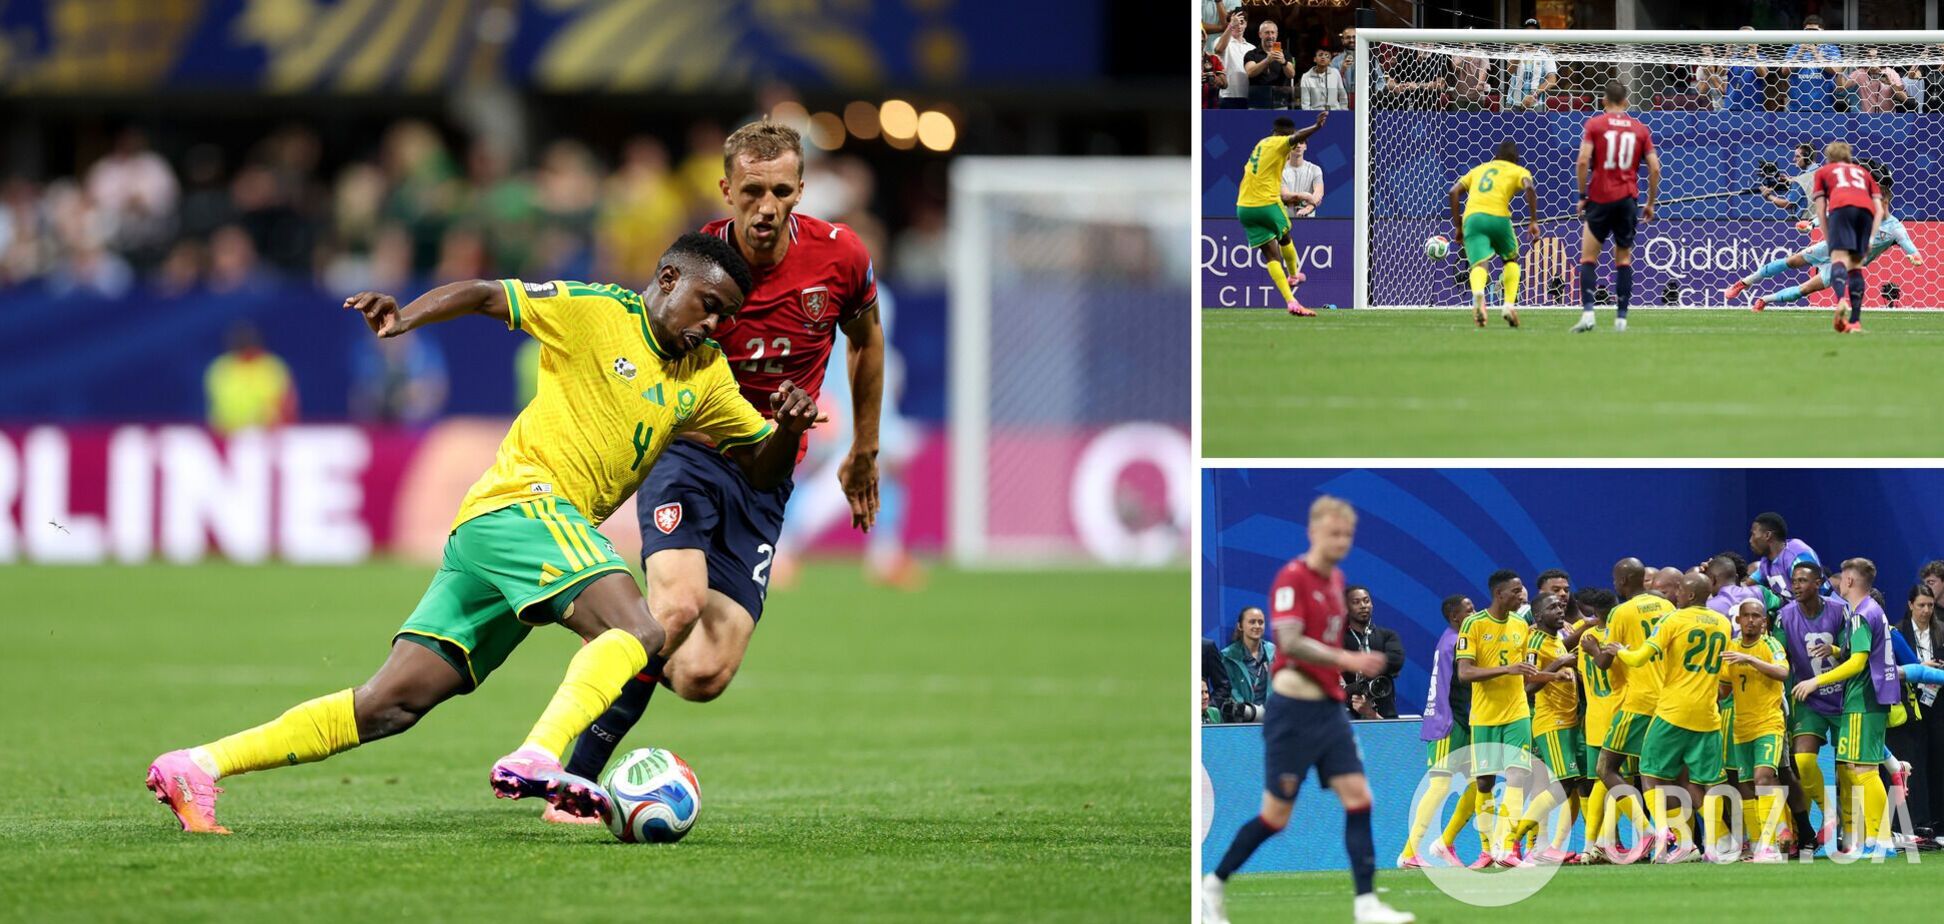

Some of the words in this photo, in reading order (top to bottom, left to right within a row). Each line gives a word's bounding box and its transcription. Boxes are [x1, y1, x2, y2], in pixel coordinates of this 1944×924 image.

[1249, 146, 1262, 174] 4
[1603, 130, 1636, 169] 10
[1478, 168, 1498, 192] 6
[1832, 167, 1866, 189] 15
[740, 337, 791, 373] 22
[631, 421, 653, 471] 4
[0, 424, 373, 563] LINE
[1499, 650, 1508, 667] 5
[1684, 629, 1727, 674] 20
[1739, 674, 1747, 692] 7
[591, 724, 616, 743] CZE
[1763, 743, 1774, 760] 7
